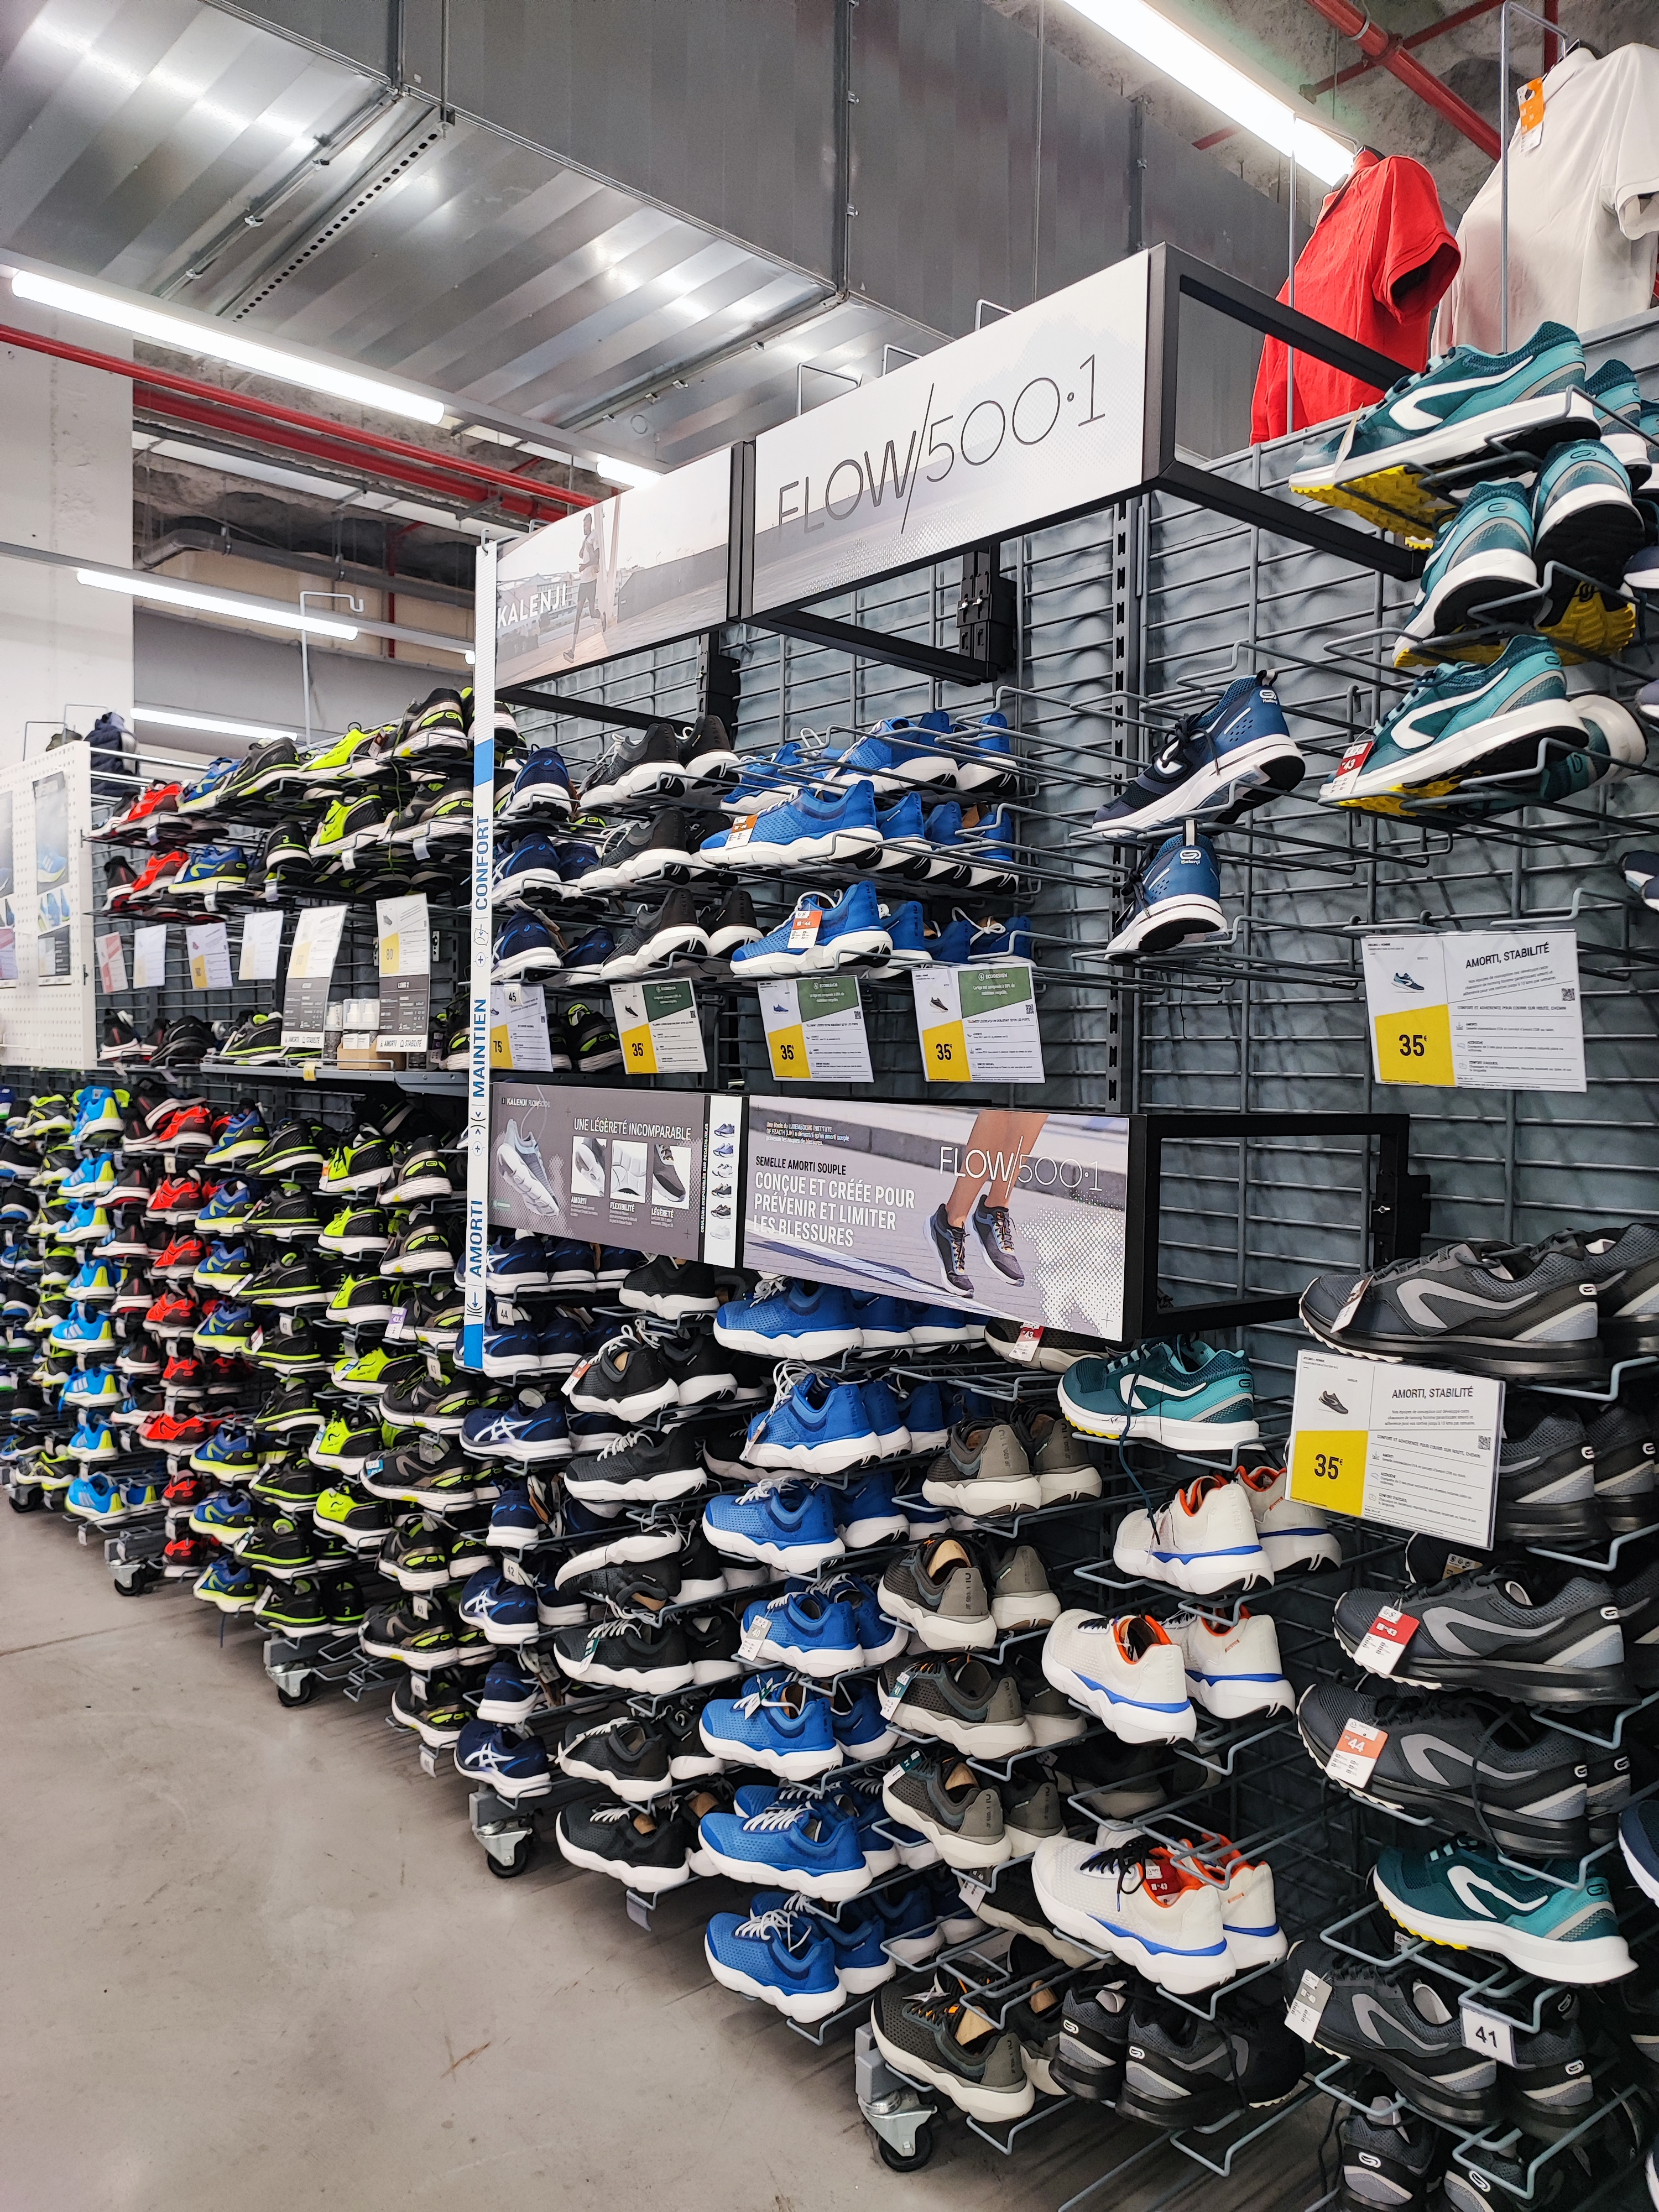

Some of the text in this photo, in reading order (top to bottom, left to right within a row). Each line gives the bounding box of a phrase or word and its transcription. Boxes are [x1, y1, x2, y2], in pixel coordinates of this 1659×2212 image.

[497, 583, 567, 628] KALENJI
[476, 816, 489, 910] CONFORT
[1465, 941, 1550, 969] AMORTI, STABILITÉ
[509, 992, 517, 1002] 45
[405, 1038, 422, 1047] STABILITÉ
[472, 999, 487, 1098] MAINTIEN
[507, 1097, 527, 1107] KALENJI
[573, 1117, 692, 1140] UNE LÉGÈRETÉ INCOMPARABLE
[812, 1125, 832, 1133] INSTITUTE
[755, 1155, 847, 1176] SEMELLE AMORTI SOUPLE
[755, 1171, 915, 1209] CONÇUE ET CRÉÉE POUR
[571, 1196, 587, 1205] AMORTI
[609, 1202, 635, 1212] FLEXIBILITÉ
[754, 1189, 896, 1231] PRÉVENIR ET LIMITER
[469, 1199, 484, 1279] AMORTI
[753, 1213, 853, 1248] LES BLESSURES
[500, 1309, 508, 1319] 44
[1024, 1329, 1034, 1339] 43
[1391, 1385, 1474, 1400] AMORTI, STABILITÉ
[507, 1566, 514, 1577] 42
[1347, 1738, 1365, 1752] 44
[1475, 2026, 1498, 2048] 41
